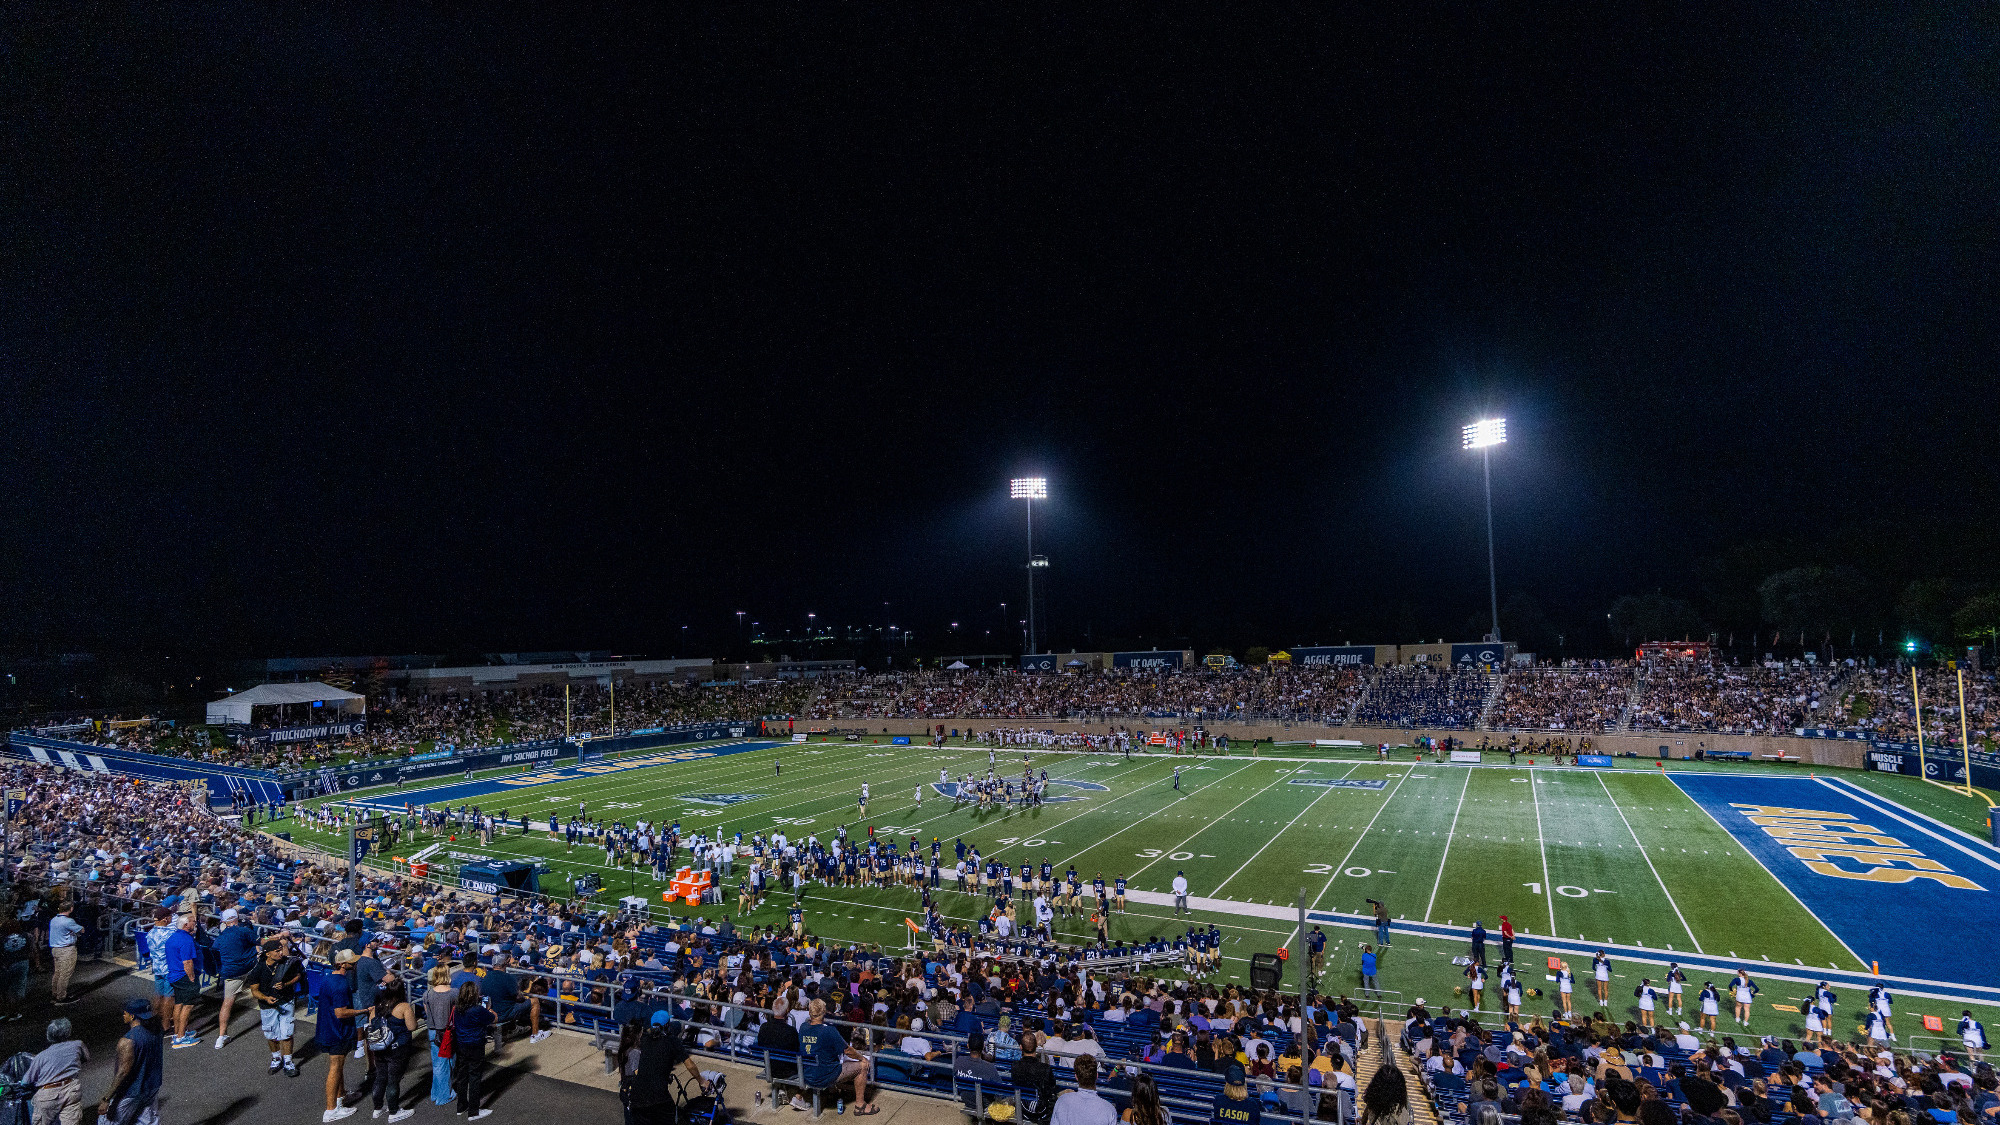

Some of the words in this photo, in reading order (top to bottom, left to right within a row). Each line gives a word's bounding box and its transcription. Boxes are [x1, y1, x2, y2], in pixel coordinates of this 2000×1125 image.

[1130, 658, 1142, 668] UC
[1142, 658, 1165, 668] DAVIS
[1303, 654, 1331, 665] AGGIE
[1333, 654, 1363, 665] PRIDE
[1409, 653, 1443, 662] #GOAGS
[270, 726, 327, 741] TOUCHDOWN
[329, 724, 351, 735] CLUB
[500, 754, 512, 763] JIM
[513, 751, 539, 761] SOCHOR
[540, 748, 559, 758] FIELD
[1870, 752, 1903, 765] MUSCLE
[1877, 762, 1899, 773] MILK
[874, 825, 922, 835] 50
[996, 837, 1047, 847] 40
[1728, 802, 1989, 891] AGGIES
[1134, 848, 1195, 861] 30
[1302, 863, 1372, 877] 20
[673, 884, 679, 893] G
[1522, 883, 1589, 898] 10
[962, 938, 967, 947] 2
[1086, 951, 1095, 960] 23
[1219, 1107, 1250, 1121] EASON
